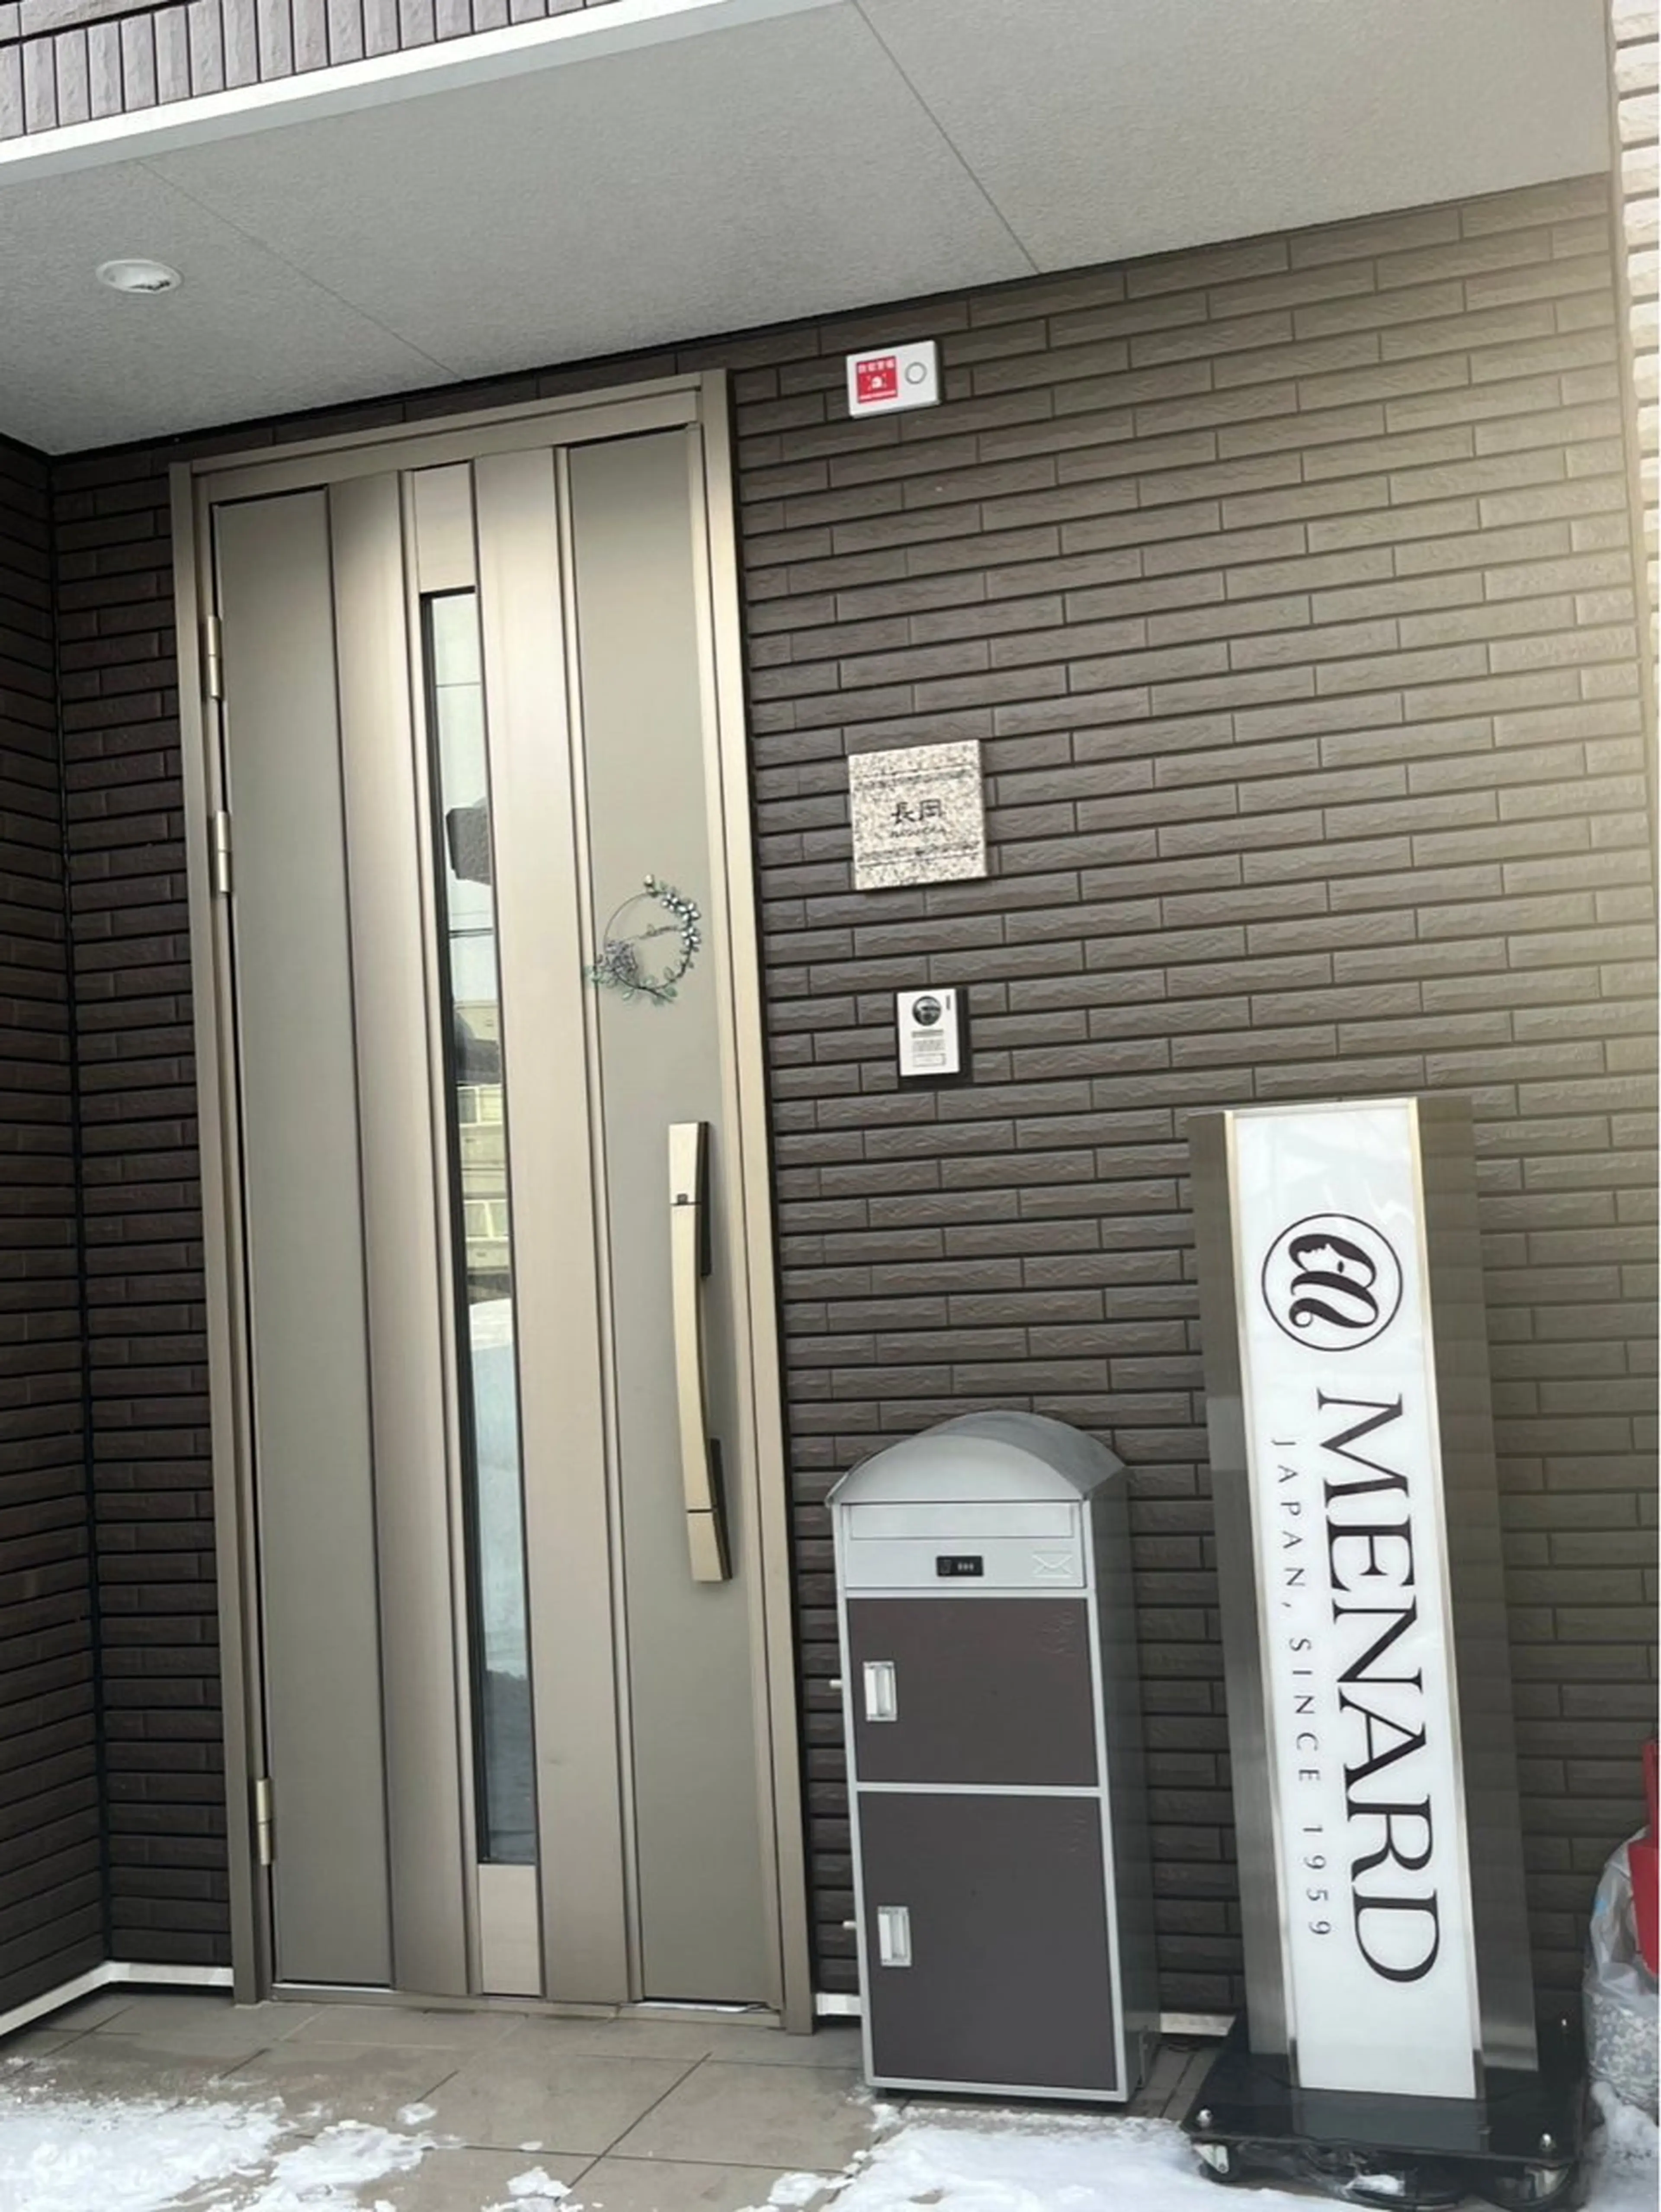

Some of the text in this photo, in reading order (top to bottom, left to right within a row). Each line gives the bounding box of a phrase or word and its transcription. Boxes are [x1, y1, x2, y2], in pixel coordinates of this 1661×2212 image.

[1271, 1439, 1331, 1936] JAPAN, SINCE 1959
[1316, 1387, 1440, 1983] MENARD
